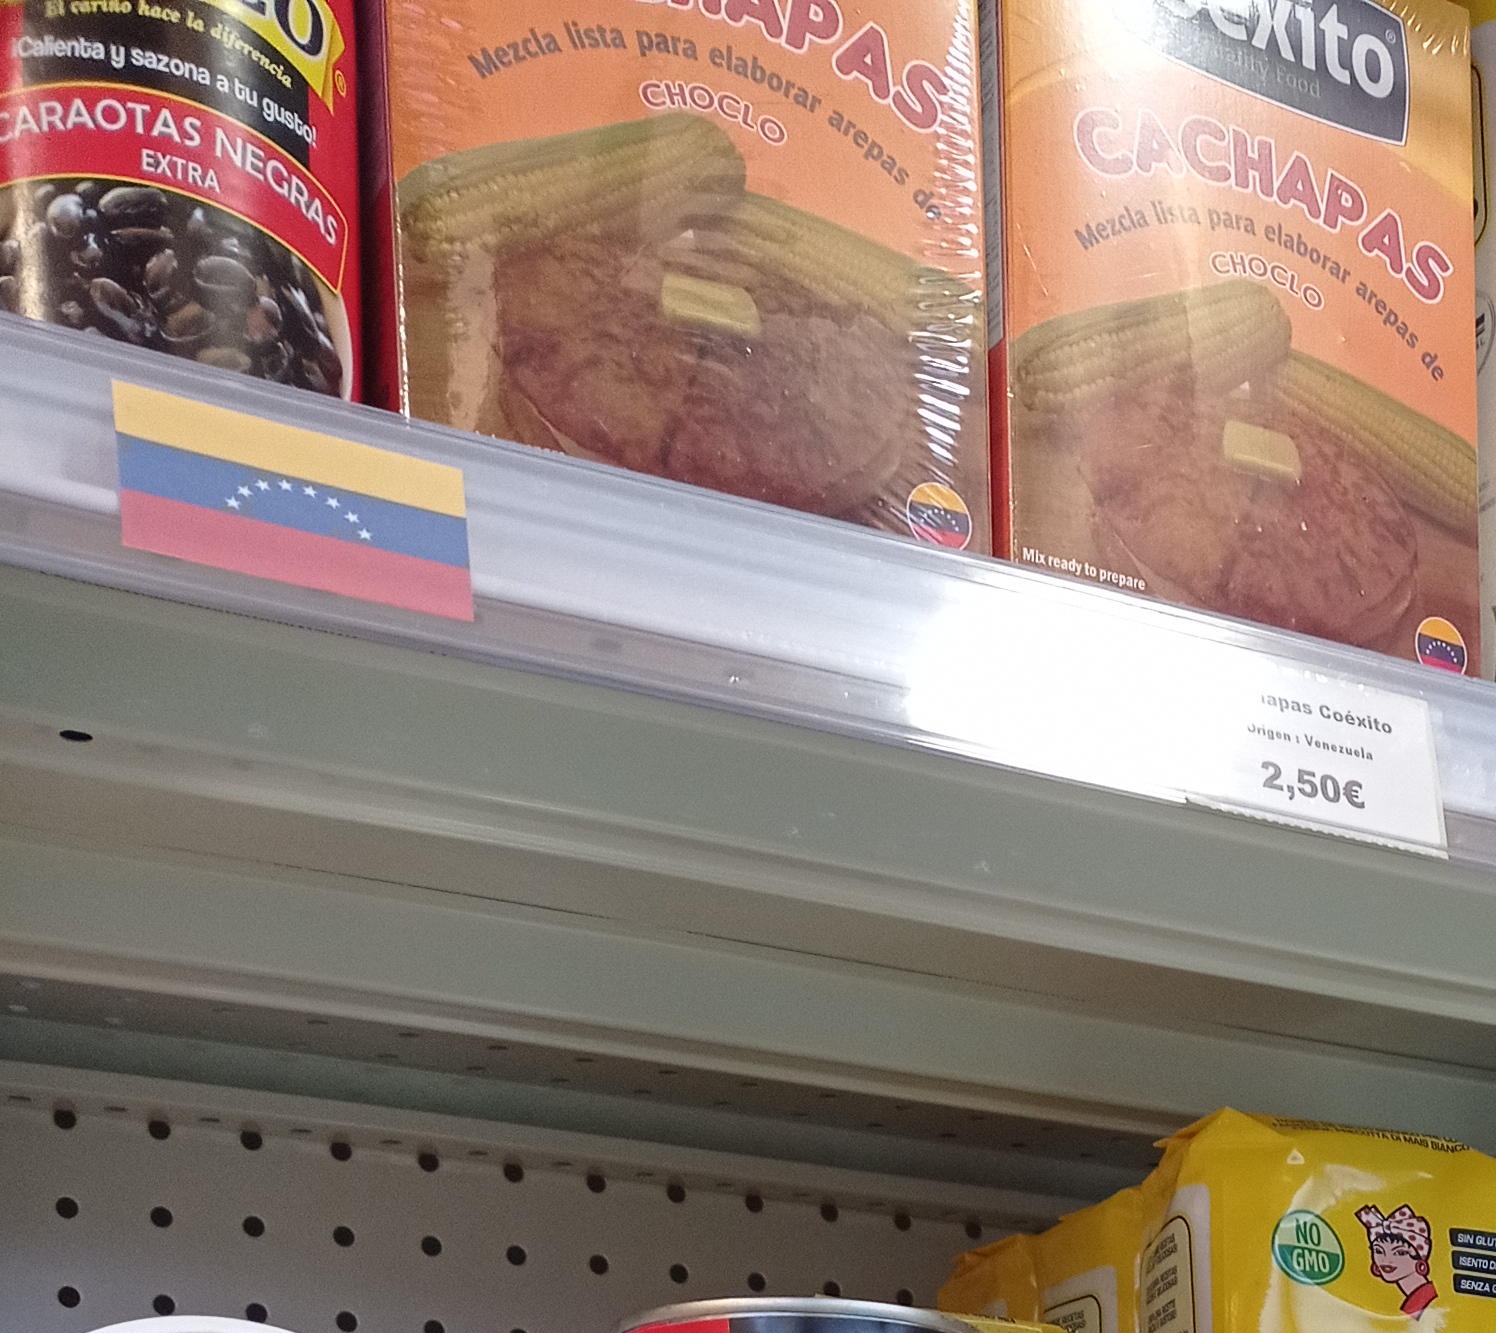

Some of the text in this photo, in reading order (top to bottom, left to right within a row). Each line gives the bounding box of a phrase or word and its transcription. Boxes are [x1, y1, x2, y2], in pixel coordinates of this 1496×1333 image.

[467, 20, 910, 187] Mezcla lista para elaborar arepas
[639, 80, 790, 146] CHOCLO
[141, 148, 220, 194] EXTRA
[214, 125, 339, 247] NEGRAS
[1073, 107, 1452, 304] CACHAPAS
[1209, 250, 1326, 309] CHOCLO
[1022, 546, 1146, 591] Mix ready to prepare
[1261, 760, 1366, 810] 2,50€
[1295, 1218, 1322, 1247] NO
[1292, 1254, 1330, 1274] GMO
